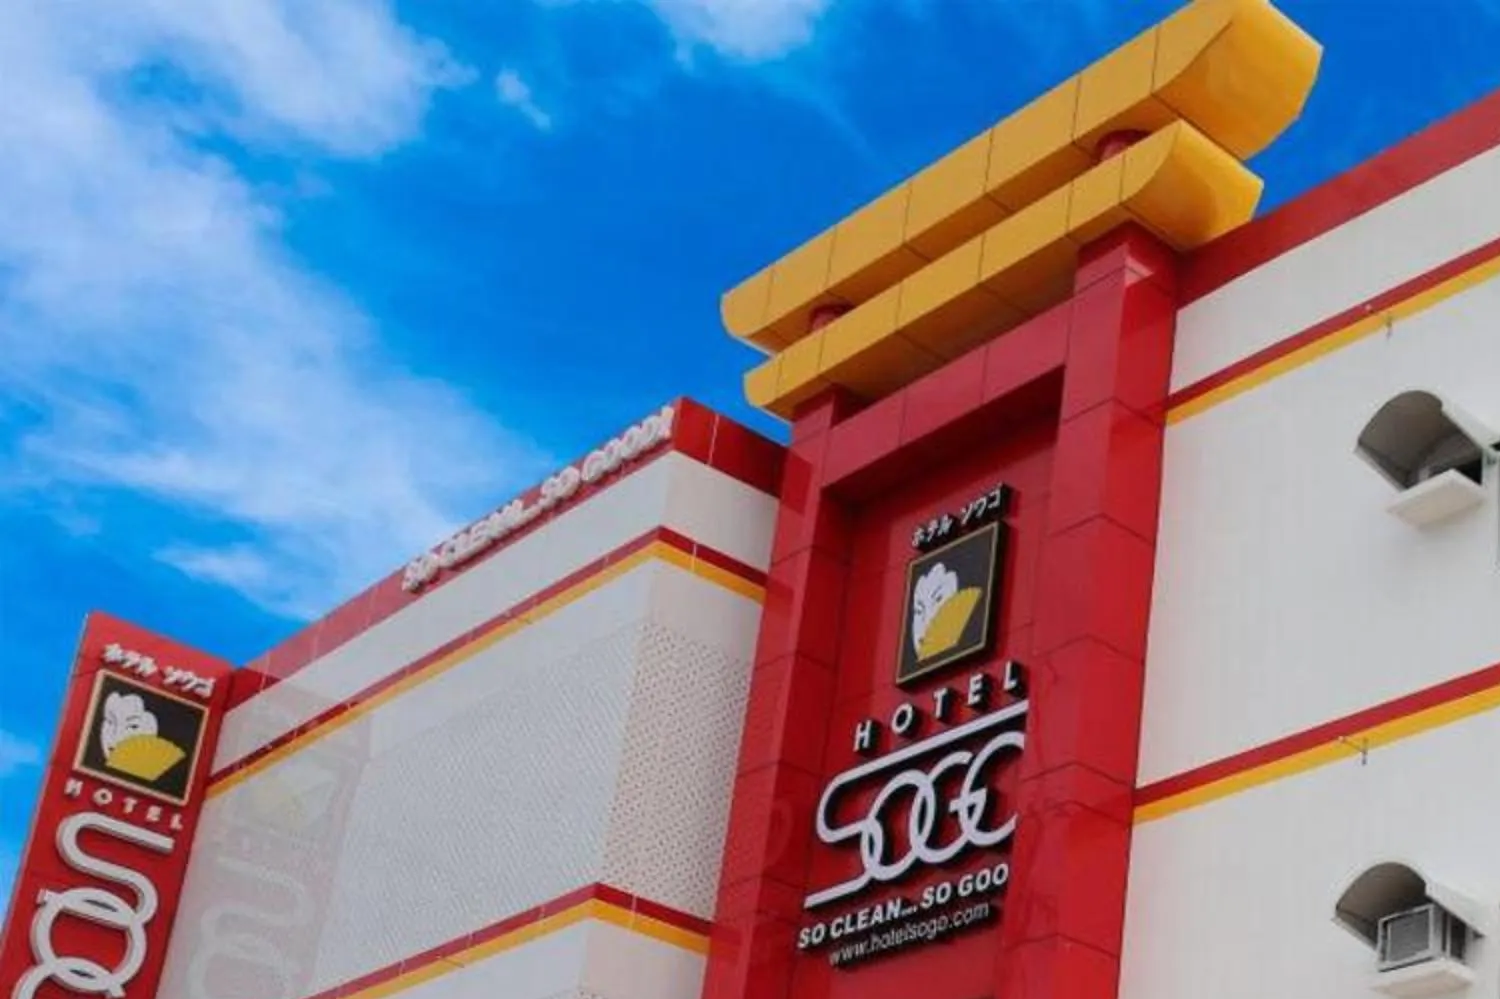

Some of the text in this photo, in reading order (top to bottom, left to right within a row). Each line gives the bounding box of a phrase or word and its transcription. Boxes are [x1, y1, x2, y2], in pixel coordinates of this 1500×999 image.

[854, 660, 1020, 752] HOTEL
[64, 778, 183, 831] HOTEL
[798, 922, 826, 949] SO
[829, 902, 990, 967] www.hotelsogo.com
